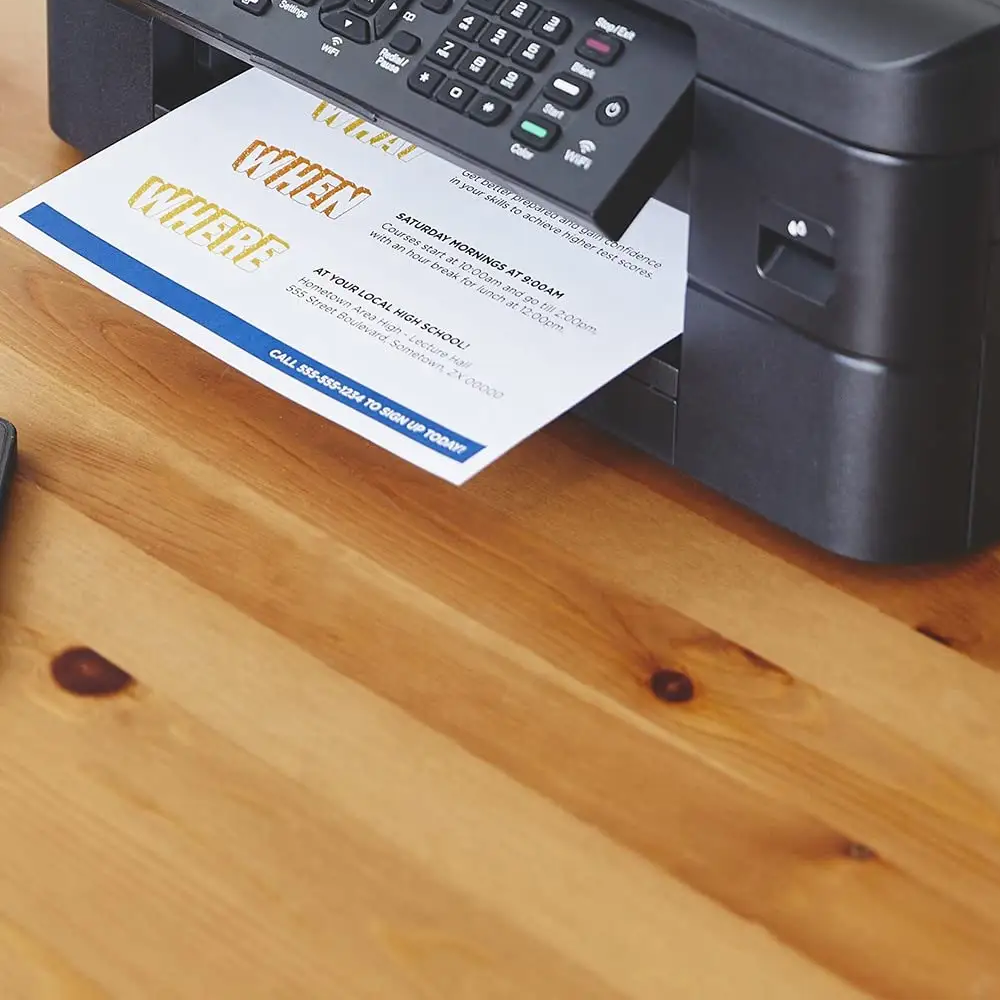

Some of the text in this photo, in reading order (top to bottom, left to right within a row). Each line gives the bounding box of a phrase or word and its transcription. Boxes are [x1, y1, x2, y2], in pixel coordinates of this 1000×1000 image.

[278, 0, 309, 20] Settings
[375, 56, 400, 74] Pause
[231, 138, 373, 220] WHEN
[480, 177, 513, 198] better
[512, 193, 560, 222] prepared
[559, 215, 580, 231] and
[604, 238, 663, 270] confidence
[127, 175, 291, 274] WHERE
[380, 221, 557, 313] Courses start at 10:00am and go till
[394, 212, 566, 301] SATURDAY MORNINGS AT 9:00AM
[449, 176, 654, 281] in your skills to achieve higher test scores.
[284, 284, 308, 299] 555
[304, 294, 338, 317] Street
[313, 266, 472, 352] AT YOUR LOCAL HIGH SCHOOL!
[369, 229, 392, 247] with
[391, 241, 408, 254] an
[405, 246, 431, 265] hour
[430, 259, 459, 281] break
[459, 274, 479, 291] for
[476, 284, 506, 304] lunch
[505, 297, 520, 310] at
[297, 276, 474, 370] Hometown Area High Lecture Hall
[268, 348, 468, 456] CALL 555-555-1234 TO SIGN UP TODAY!
